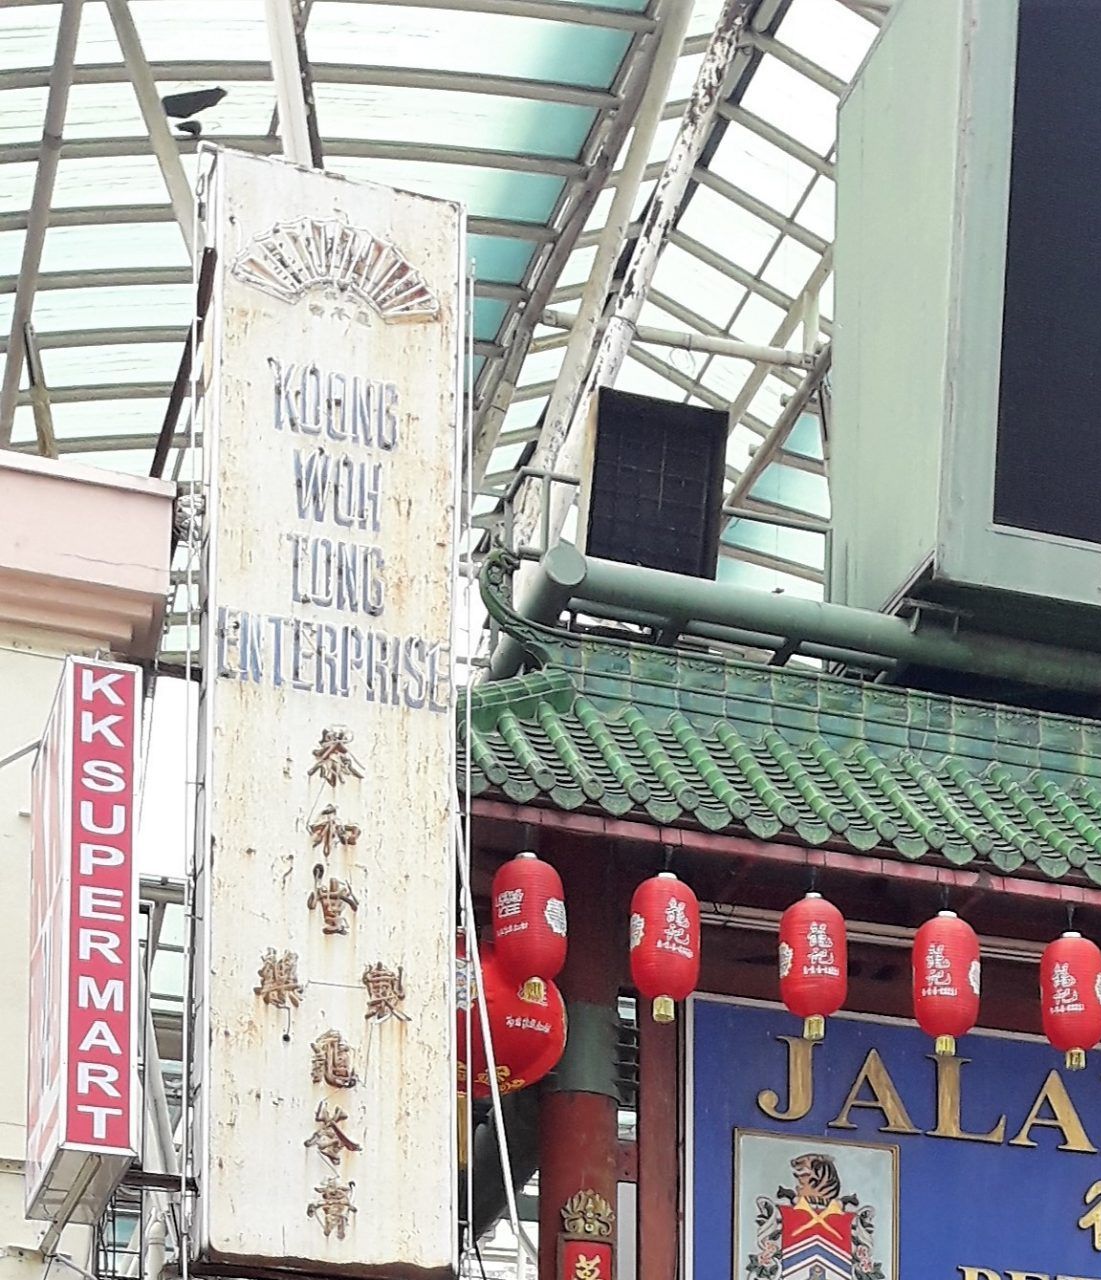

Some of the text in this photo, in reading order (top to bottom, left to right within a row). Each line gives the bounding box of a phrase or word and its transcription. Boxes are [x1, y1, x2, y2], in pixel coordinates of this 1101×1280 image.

[268, 357, 399, 451] KOONG
[294, 447, 381, 531] WOH
[286, 533, 385, 616] TONG
[216, 607, 450, 714] ENTERPRISE
[76, 757, 126, 1140] SUPERMART
